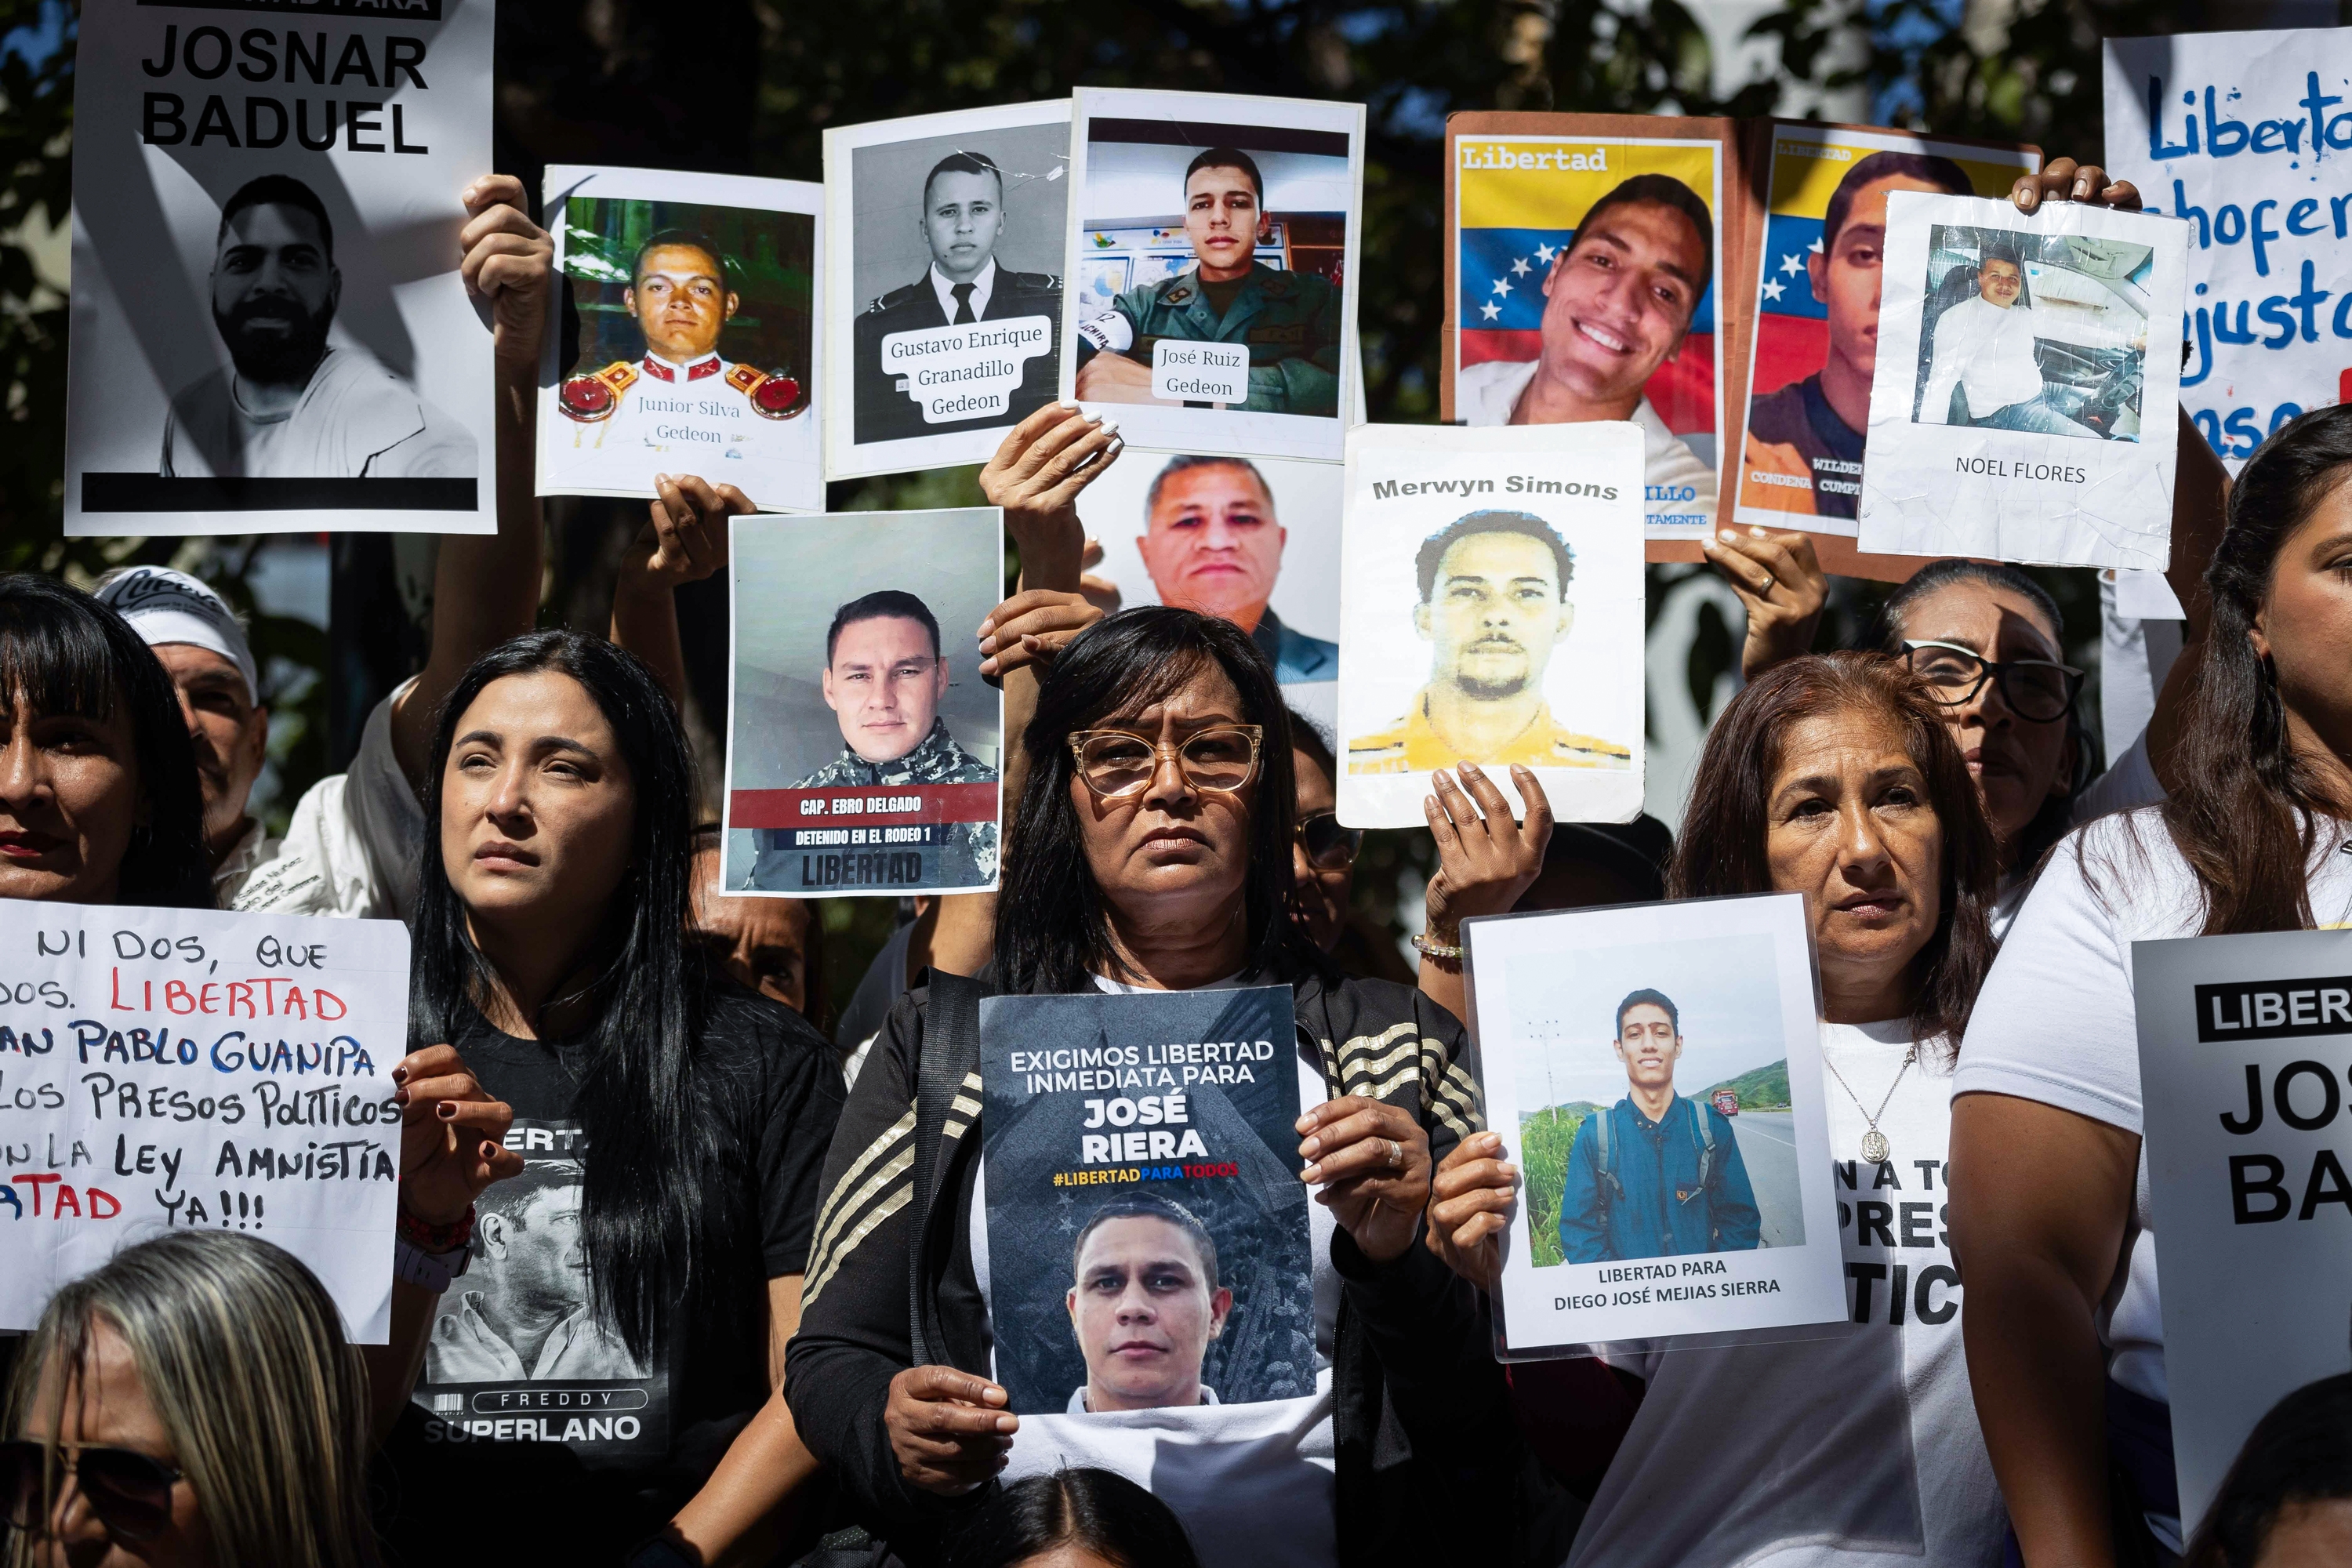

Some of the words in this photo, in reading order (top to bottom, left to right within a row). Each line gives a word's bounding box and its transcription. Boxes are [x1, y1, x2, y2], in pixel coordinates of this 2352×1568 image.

[142, 25, 429, 89] JOSNAR
[143, 92, 429, 154] BADUEL
[1463, 146, 1607, 172] Libertad
[1777, 143, 1852, 162] LIBERTAD
[891, 338, 963, 358] Gustavo
[968, 328, 1043, 349] Enrique
[1161, 349, 1196, 367] José
[1203, 350, 1240, 368] Ruiz
[918, 360, 1014, 386] Granadillo
[1167, 378, 1233, 395] Gedeon
[638, 397, 694, 413] Junior
[699, 401, 740, 418] Silva
[932, 394, 1000, 415] Gedeon
[657, 424, 721, 443] Gedeon
[1751, 471, 1813, 490] CONDENA
[1956, 457, 2007, 477] NOEL
[2014, 463, 2085, 483] FLORES
[1373, 477, 1494, 500] Merwyn
[1505, 475, 1619, 500] Simons
[800, 798, 829, 816] CAP.
[832, 797, 863, 815] EBRO
[866, 796, 921, 814] DELGADO
[796, 829, 848, 846] DETENIDO
[851, 829, 866, 844] EN
[869, 828, 882, 844] EL
[885, 828, 920, 844] RODEO
[924, 827, 931, 842] 1
[802, 852, 922, 886] LIBERTAD
[38, 929, 86, 959] NI
[112, 930, 218, 974] DOS,
[256, 935, 328, 970] QUE
[111, 967, 347, 1021] LIBERTAD
[67, 1020, 198, 1065] PABLO
[210, 1031, 376, 1077] GUANIPA
[1011, 1046, 1139, 1073] EXIGIMOS
[1148, 1040, 1274, 1065] LIBERTAD
[1027, 1067, 1176, 1094] INMEDIATA
[1183, 1064, 1255, 1086] PARA
[82, 1073, 246, 1125] PRESOS
[1083, 1087, 1188, 1129] JOSÉ
[2220, 1060, 2352, 1135] JO
[1082, 1129, 1209, 1164] RIERA
[48, 1132, 93, 1169] LA
[115, 1134, 183, 1192] LEY
[1872, 1160, 1902, 1190] A
[1599, 1264, 1677, 1283] LIBERTAD
[1682, 1260, 1727, 1276] PARA
[1555, 1294, 1607, 1311] DIEGO
[1612, 1287, 1650, 1306] JOSÉ
[1657, 1284, 1716, 1302] MEJIAS
[1721, 1279, 1780, 1297] SIERRA
[501, 1393, 612, 1406] FREDDY
[424, 1416, 641, 1443] SUPERLANO
